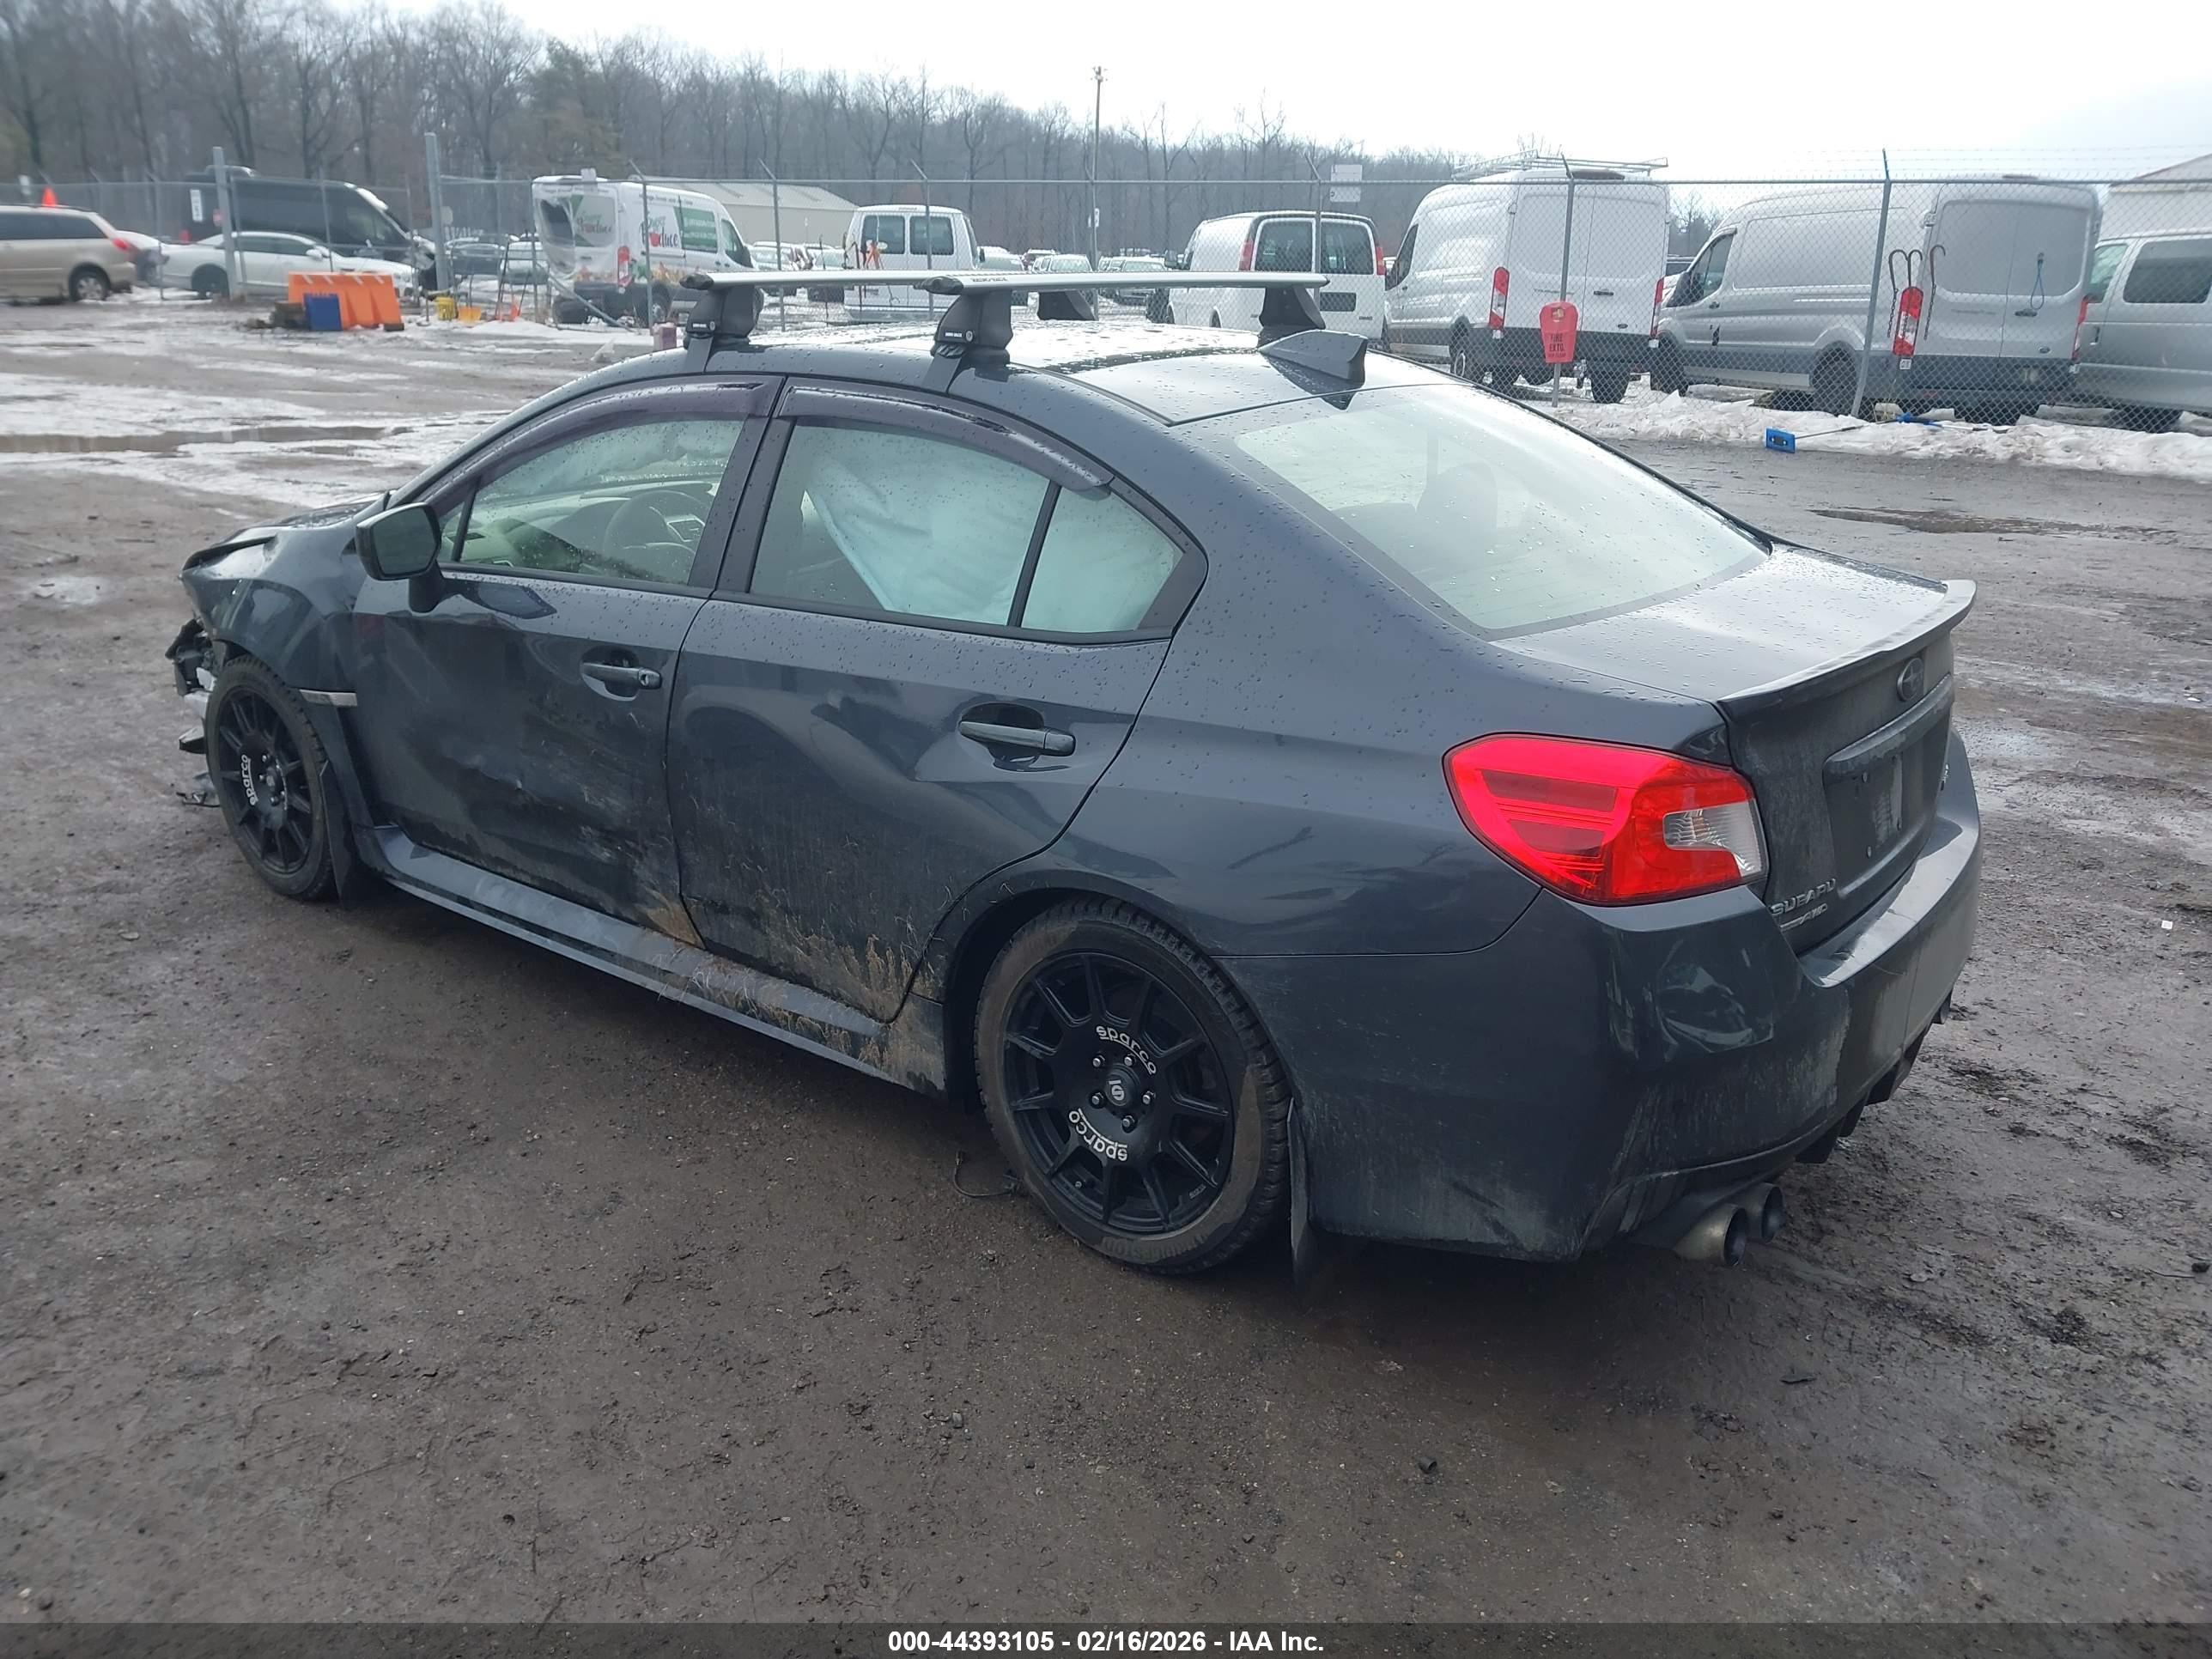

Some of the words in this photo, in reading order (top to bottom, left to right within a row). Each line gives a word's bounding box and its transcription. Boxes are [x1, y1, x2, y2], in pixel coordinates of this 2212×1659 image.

[241, 754, 258, 805] sparco
[1771, 878, 1836, 916] SUBARU
[1096, 1025, 1157, 1075] sparco
[1068, 1109, 1128, 1162] sparco
